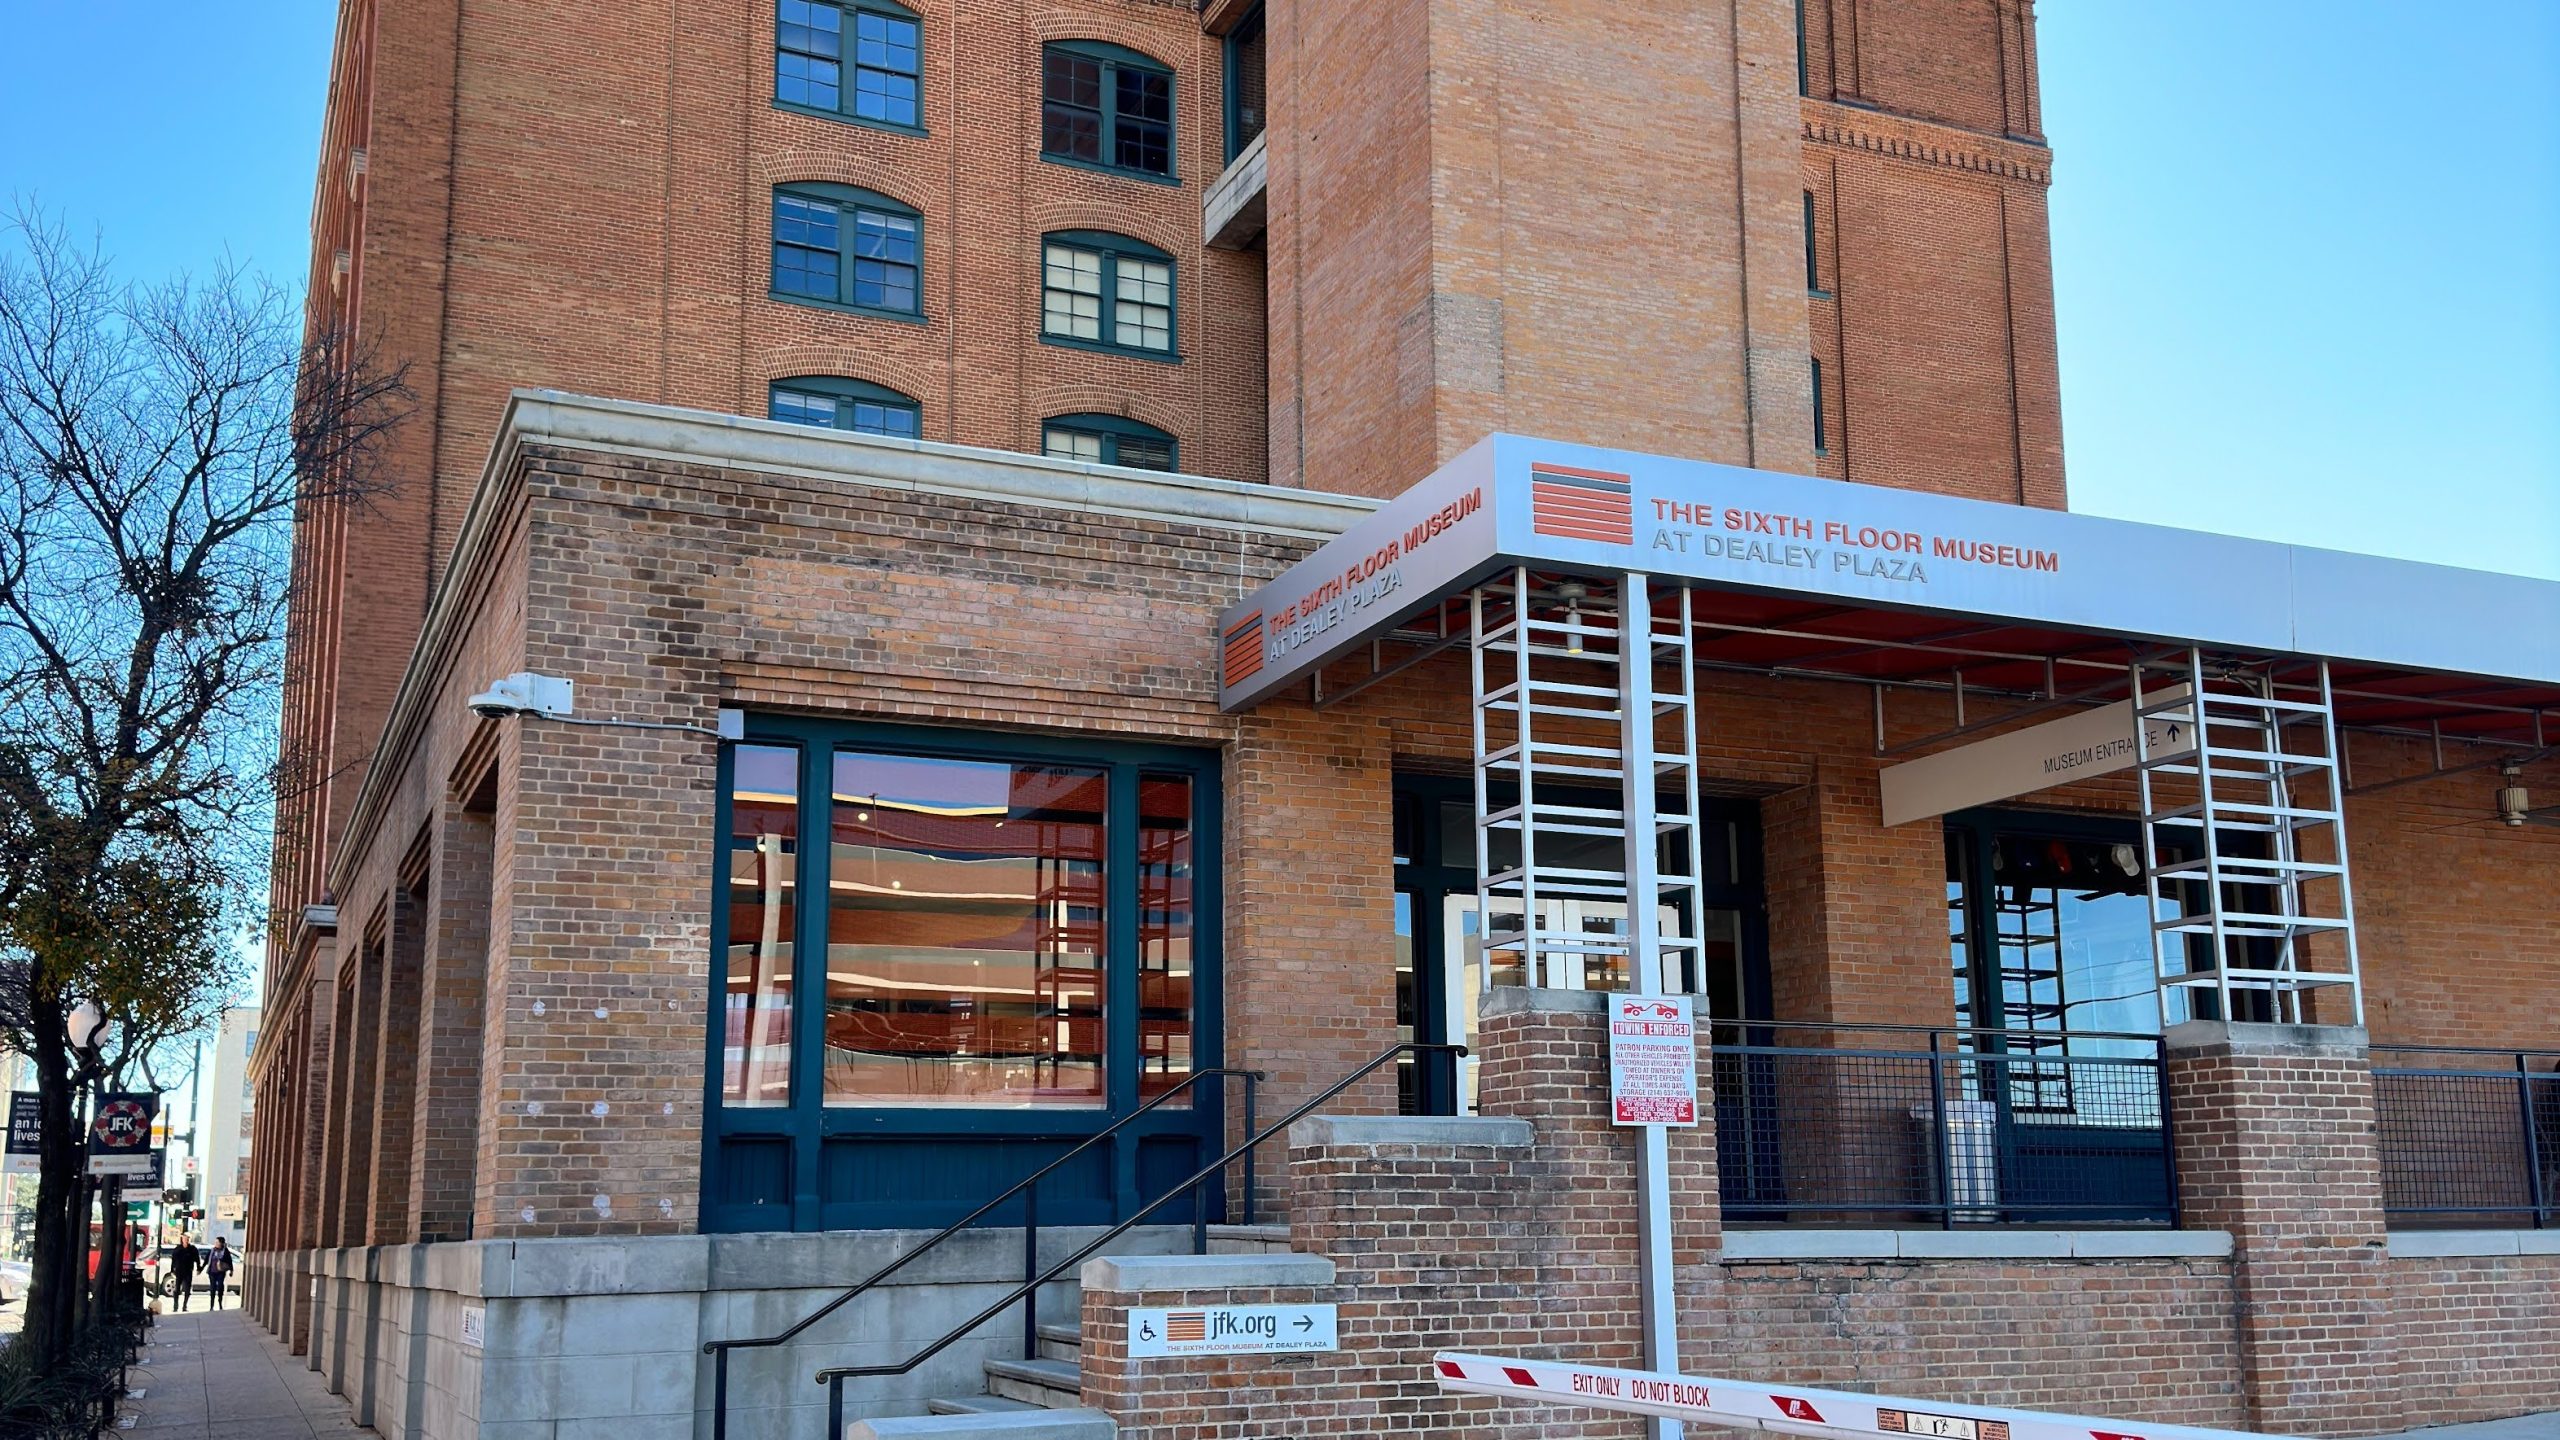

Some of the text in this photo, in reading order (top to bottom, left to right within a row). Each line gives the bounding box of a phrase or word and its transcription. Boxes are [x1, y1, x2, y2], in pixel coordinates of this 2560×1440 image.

[1651, 498, 2060, 573] THE SIXTH FLOOR MUSEUM
[1269, 487, 1482, 636] THE SIXTH FLOOR MUSEUM
[1652, 527, 1929, 584] AT DEALEY PLAZA
[1268, 567, 1402, 663] AT DEALEY PLAZA
[2043, 730, 2158, 774] MUSEUM ENTRACE
[1615, 1022, 1689, 1036] TOWING ENFORCED
[1615, 1043, 1690, 1053] PATRON PARKING ONLY
[14, 1119, 30, 1129] an
[110, 1116, 134, 1131] JFK
[13, 1129, 41, 1142] lives
[127, 1173, 145, 1181] lives
[1211, 1311, 1277, 1340] jfk.org
[1275, 1341, 1302, 1349] DEALEY
[1573, 1373, 1711, 1408] EXIT ONLY DO NOT BLOCK
